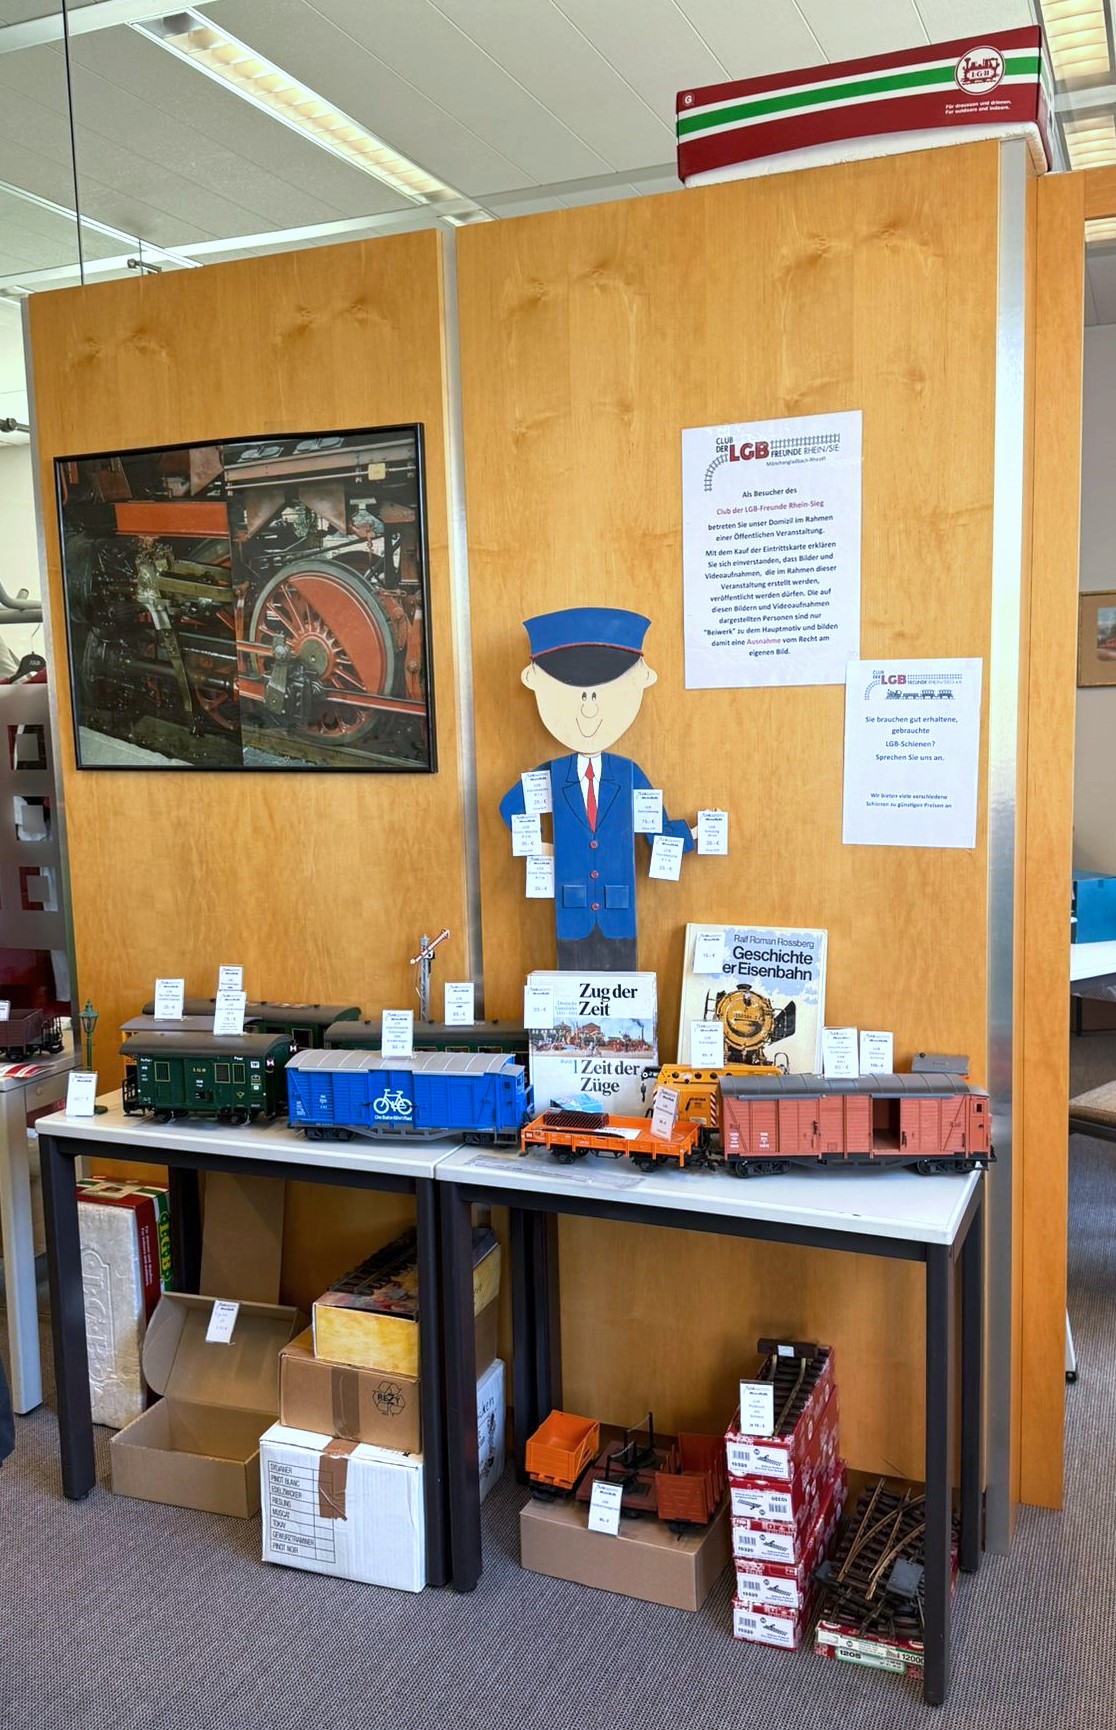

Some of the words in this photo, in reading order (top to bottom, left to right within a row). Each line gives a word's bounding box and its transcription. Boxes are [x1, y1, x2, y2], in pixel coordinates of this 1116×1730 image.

[716, 436, 734, 445] CLUB
[716, 445, 729, 453] DER
[729, 441, 770, 462] LGB
[770, 449, 802, 458] FREUNDE
[754, 488, 784, 498] Besucher
[716, 507, 732, 516] Club
[732, 506, 744, 514] der
[745, 502, 788, 513] LGB-Freunde
[788, 500, 824, 510] Rhein-Sieg
[708, 522, 736, 530] betreten
[768, 518, 794, 526] Domizil
[805, 514, 834, 523] Rahmen
[734, 530, 775, 540] Öffentlichen
[776, 527, 826, 538] Veranstaltung.
[762, 543, 806, 553] Eintrittskarte
[808, 541, 836, 550] erklären
[732, 557, 782, 567] einverstanden,
[782, 556, 798, 564] dass
[799, 554, 819, 562] Bilder
[820, 552, 834, 560] und
[764, 568, 776, 576] die
[786, 566, 815, 574] Rahmen
[816, 564, 837, 572] dieser
[720, 580, 766, 590] Veranstaltung
[768, 580, 791, 588] erstellt
[792, 578, 820, 586] werden,
[754, 591, 780, 600] werden
[781, 589, 806, 598] dürfen.
[807, 588, 818, 596] Die
[820, 588, 832, 596] auf
[712, 605, 733, 614] diesen
[734, 604, 758, 612] Bildern
[758, 603, 772, 611] und
[772, 600, 830, 610] Videoaufnahmen
[718, 616, 762, 625] dargestellten
[762, 614, 794, 622] Personen
[794, 612, 808, 620] sind
[762, 624, 802, 634] Hauptmotiv
[816, 622, 838, 630] bilden
[712, 638, 730, 647] damit
[746, 638, 782, 646] Ausnahme
[798, 634, 818, 643] Recht
[749, 649, 775, 658] eigenen
[776, 648, 790, 656] Bild.
[880, 674, 907, 685] LGB
[876, 754, 906, 762] Sprechen
[734, 934, 748, 943] Ralf
[749, 935, 776, 946] Roman
[777, 938, 814, 950] Rossberg
[732, 946, 813, 965] Geschichte
[722, 963, 737, 974] er
[738, 962, 812, 981] Eisenbahn
[580, 983, 610, 1002] Zug
[612, 984, 638, 998] der
[578, 1001, 610, 1016] Zeit
[580, 1060, 613, 1075] Zeit
[614, 1061, 640, 1076] der
[580, 1077, 620, 1096] Züge
[378, 1394, 400, 1404] REZY
[271, 1474, 284, 1484] PINOT
[284, 1478, 300, 1488] BLANC
[272, 1509, 290, 1518] MUSCAT
[272, 1542, 286, 1551] PINOT
[286, 1545, 298, 1554] NOIR
